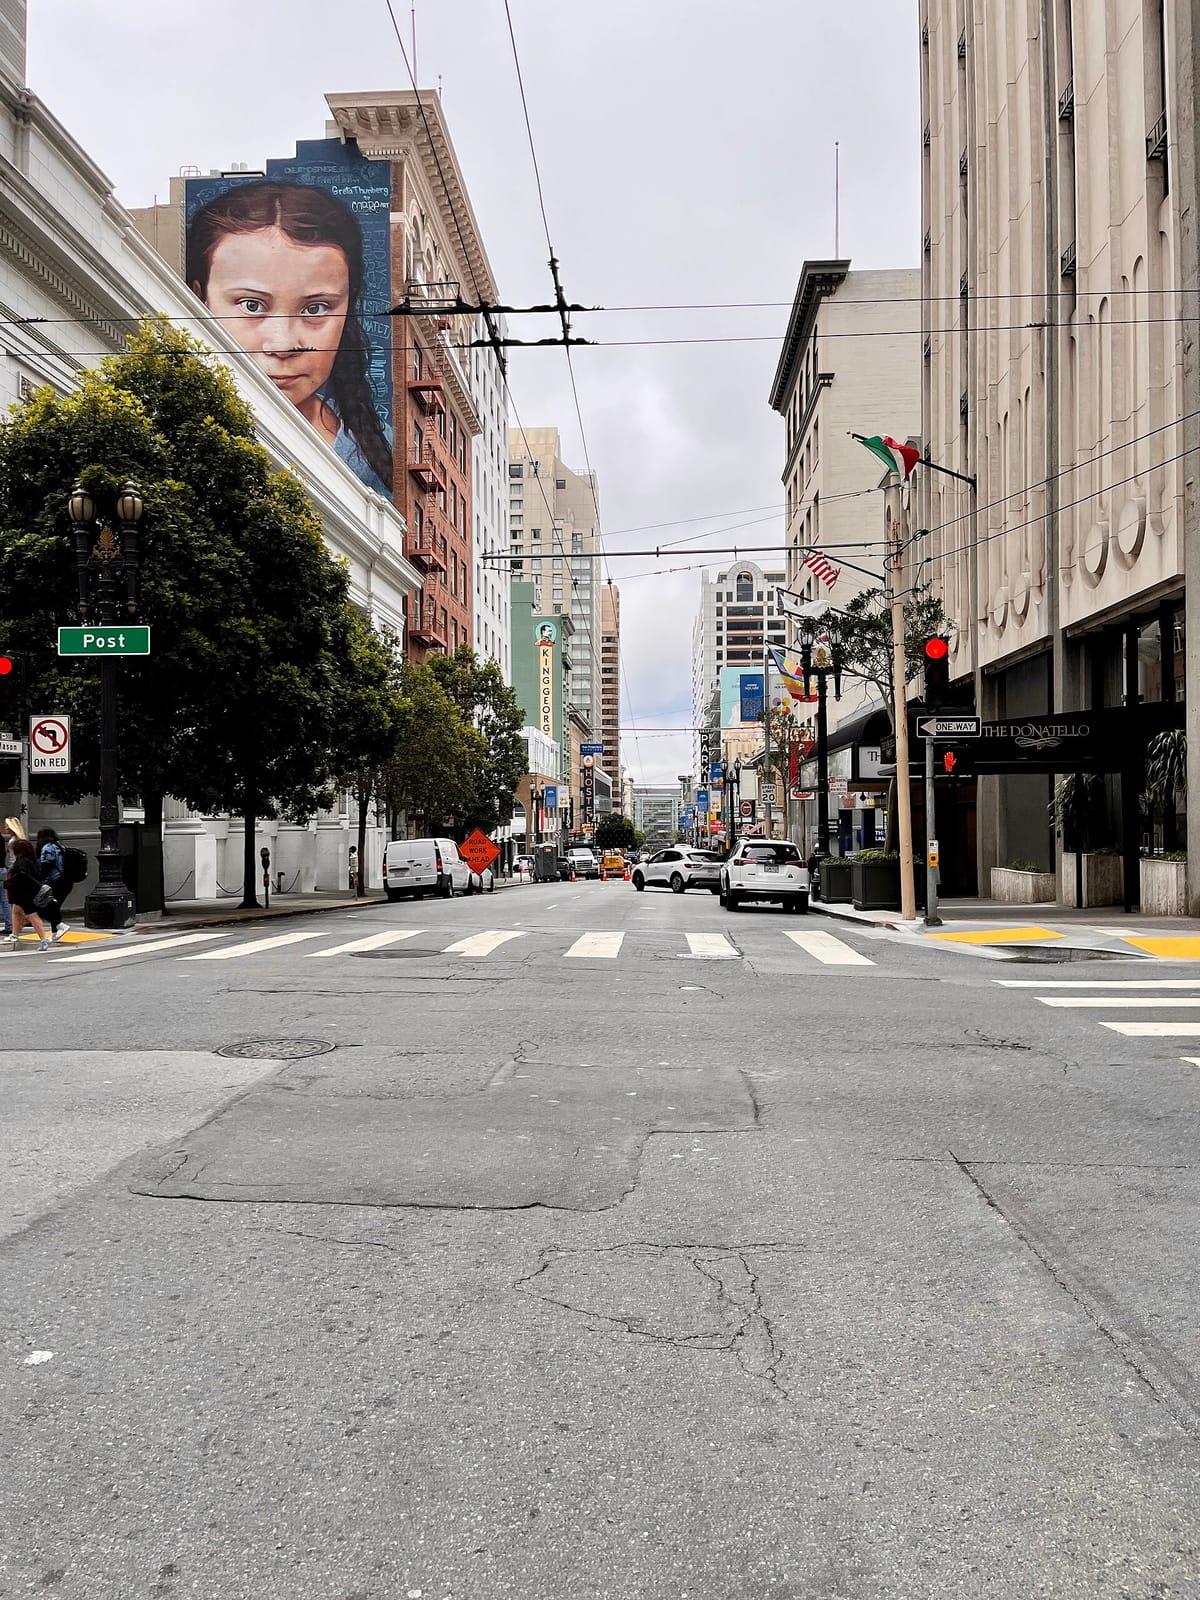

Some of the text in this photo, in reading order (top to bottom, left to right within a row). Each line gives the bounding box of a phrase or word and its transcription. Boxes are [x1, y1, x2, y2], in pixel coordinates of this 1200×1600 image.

[332, 186, 389, 197] Greta Thunberg
[83, 634, 125, 648] Post
[542, 688, 550, 735] GEORG
[936, 721, 974, 731] ONE WAY
[981, 724, 1090, 738] THE DONATELLO
[867, 751, 880, 761] TH
[34, 758, 66, 767] ON RED
[584, 769, 593, 824] HOSTEL
